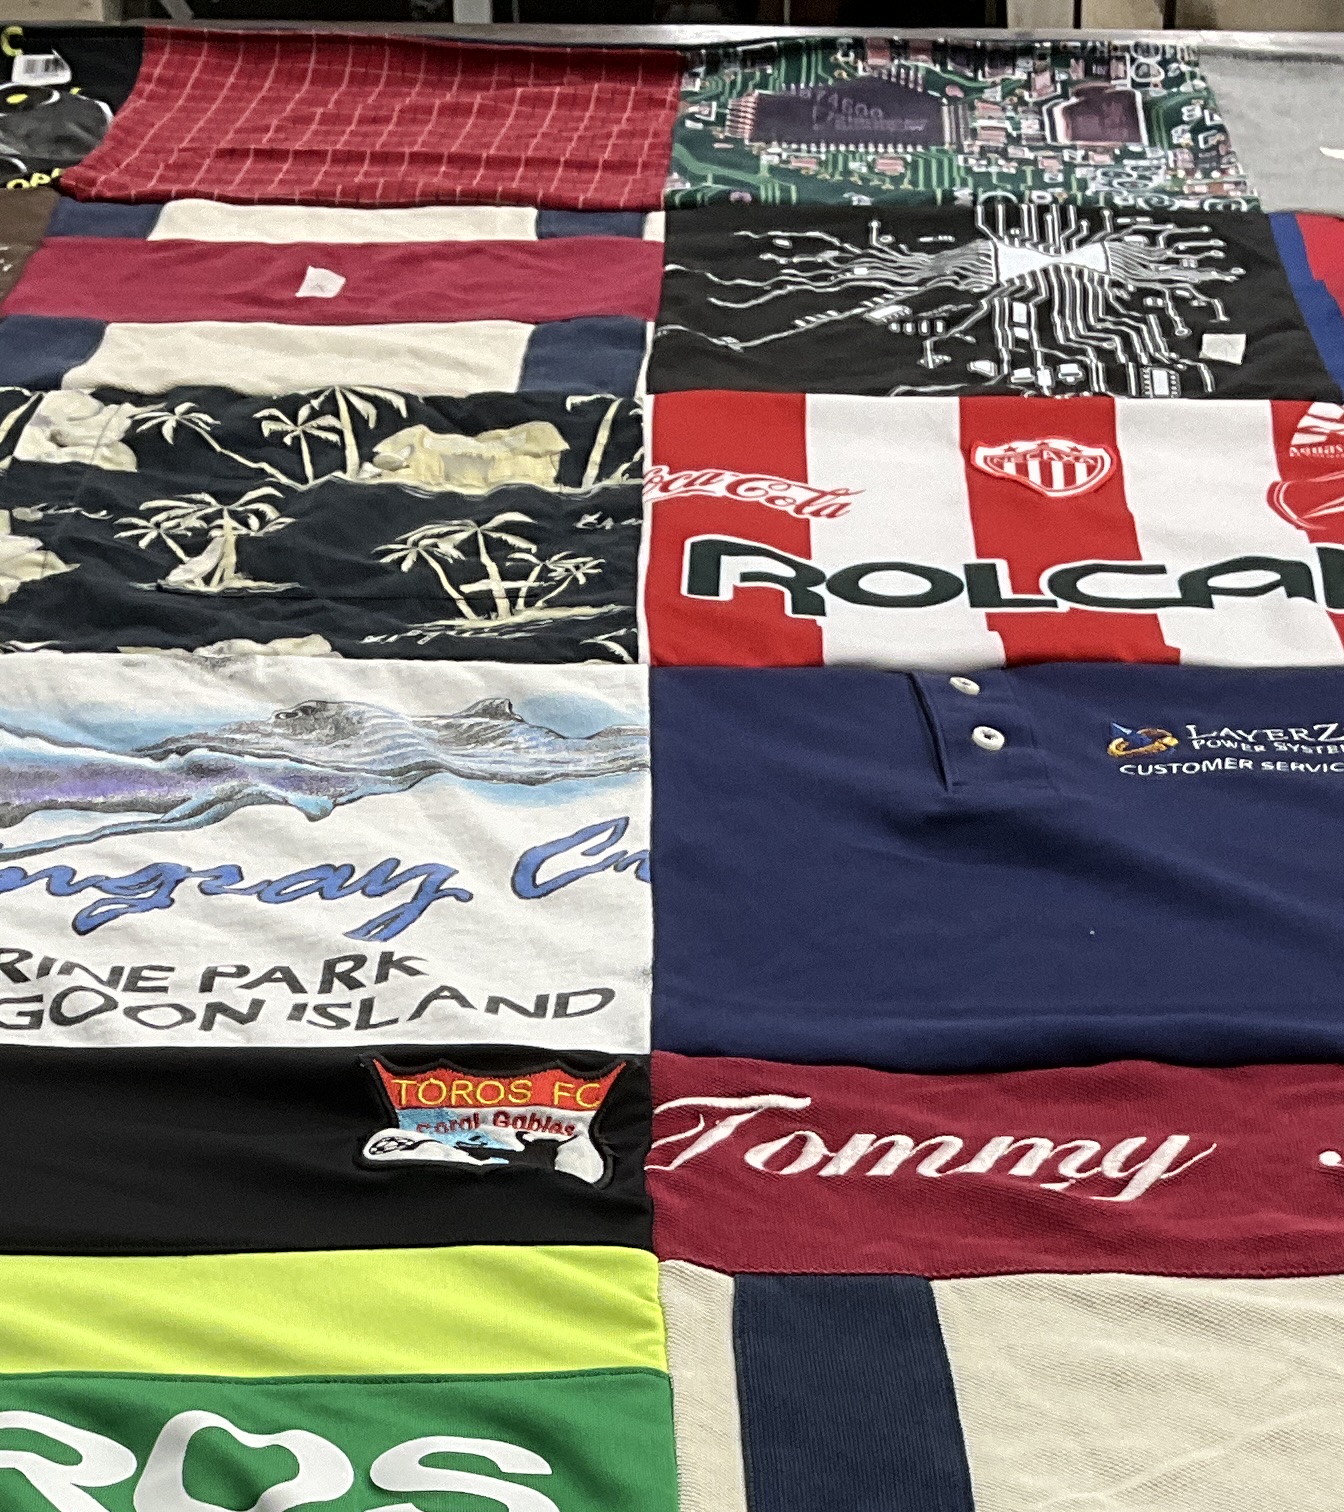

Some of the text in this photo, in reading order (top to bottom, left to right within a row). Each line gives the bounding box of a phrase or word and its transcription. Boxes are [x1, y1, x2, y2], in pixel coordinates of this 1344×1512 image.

[1191, 738, 1266, 753] POWER
[1118, 757, 1255, 776] CUSTOMER
[197, 950, 430, 995] PARK
[286, 984, 617, 1032] ISLAND
[391, 1077, 602, 1109] TOROS FC
[492, 1109, 576, 1138] Gables
[643, 1092, 1218, 1202] Tommy
